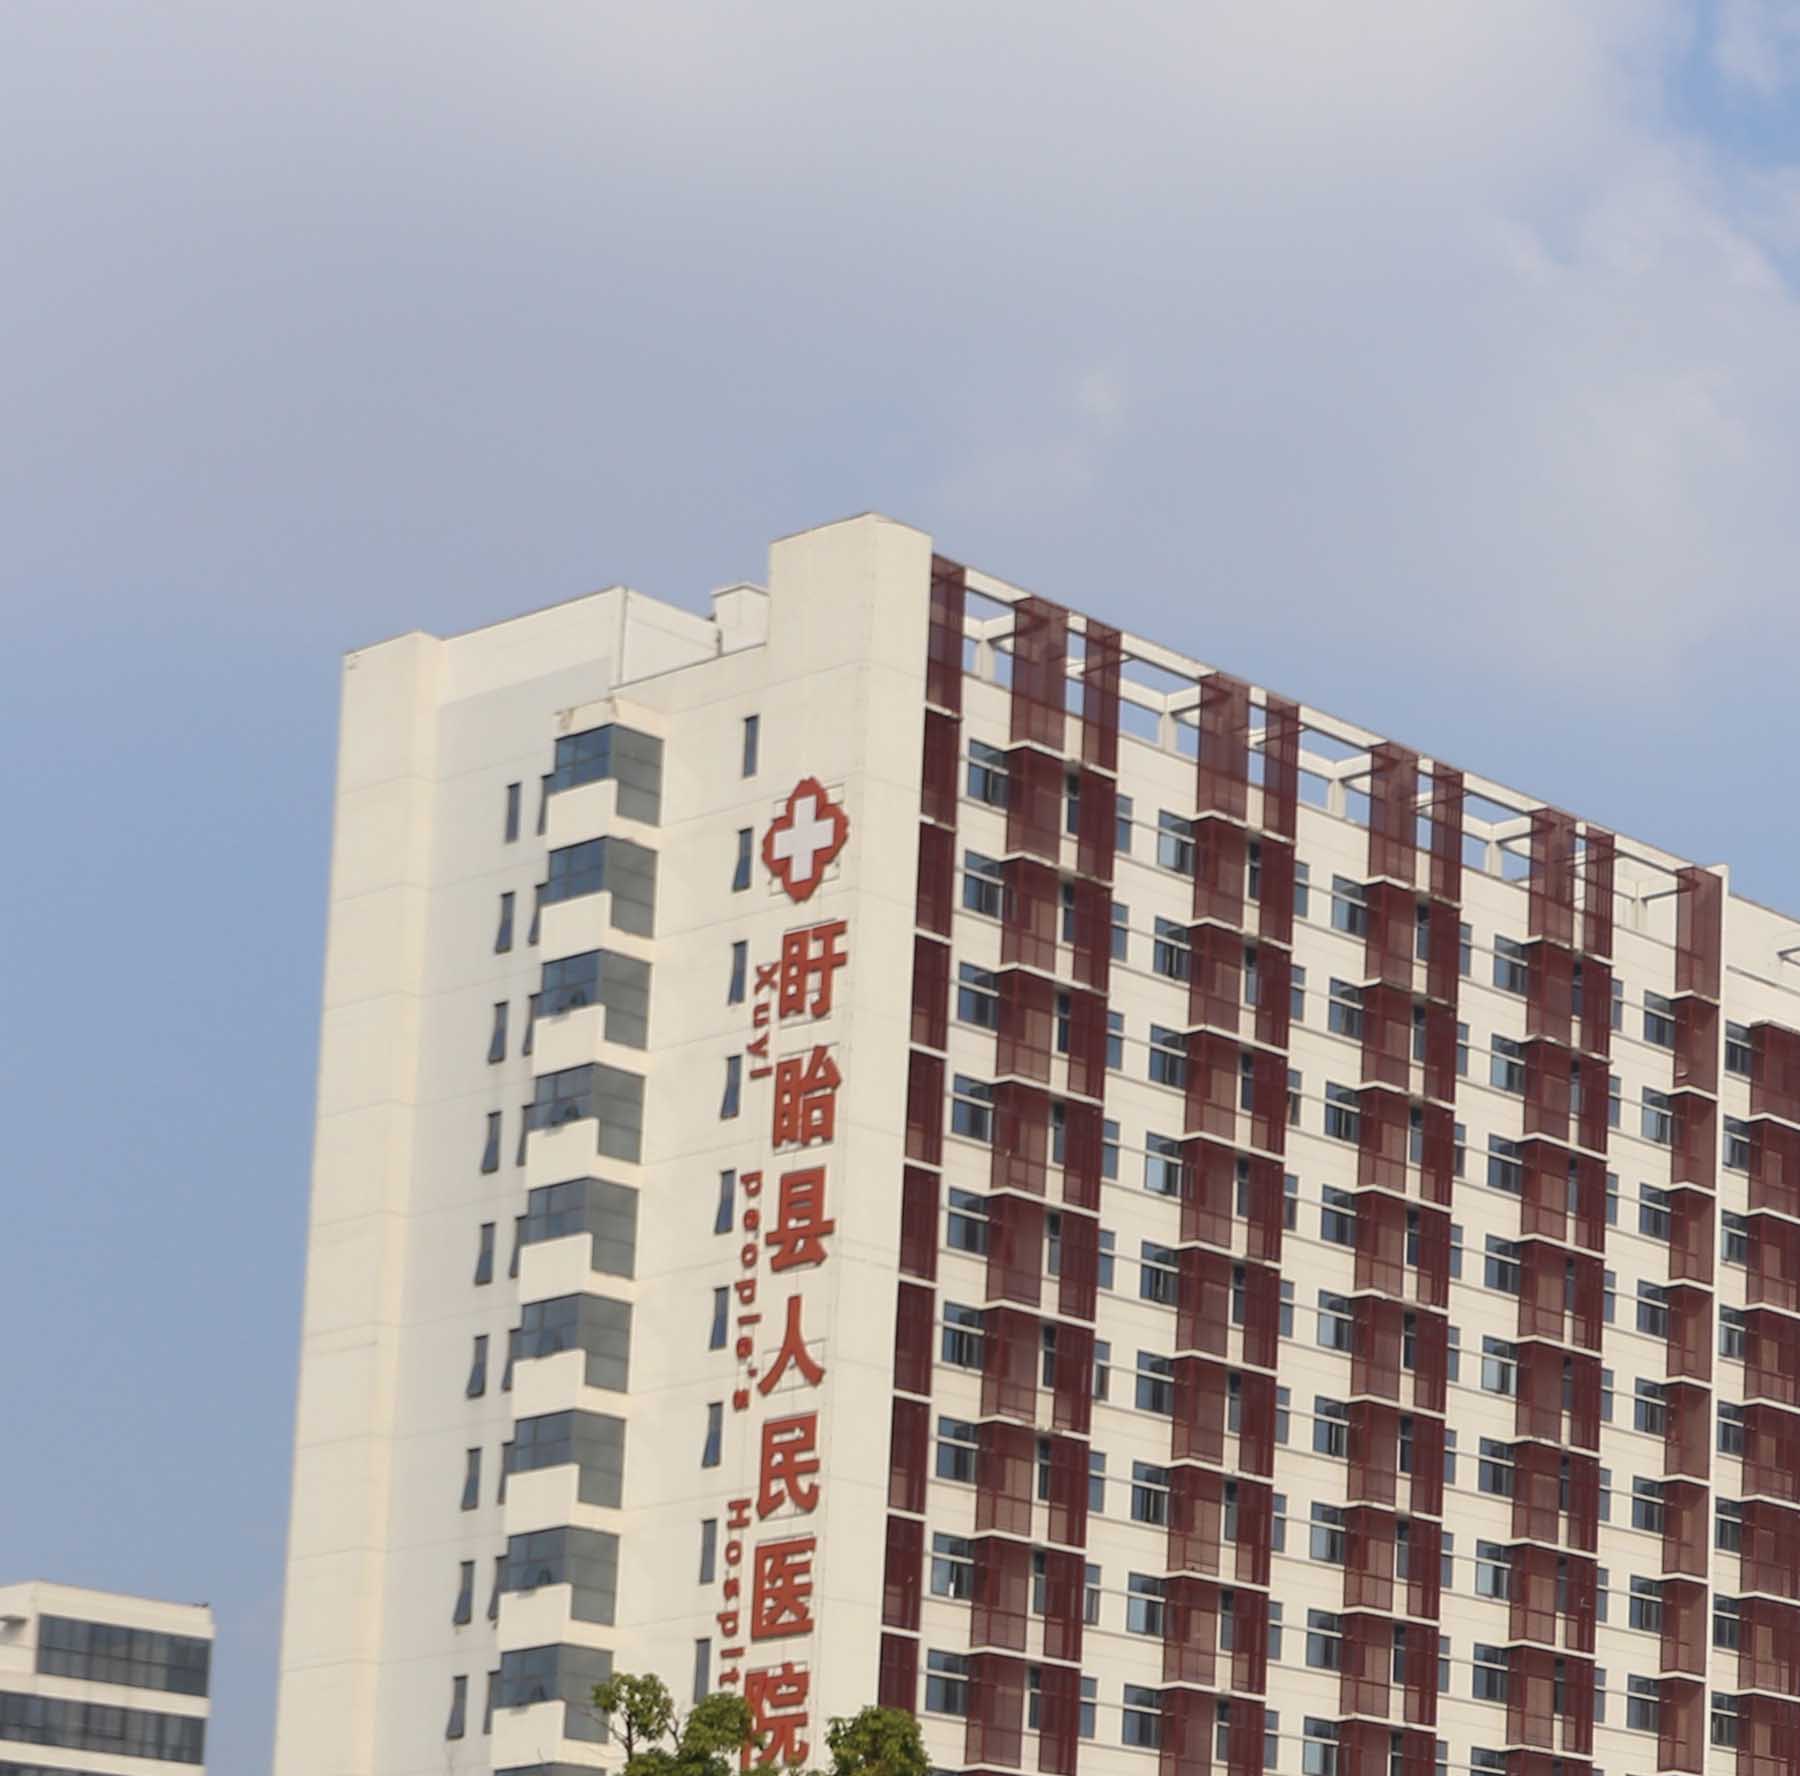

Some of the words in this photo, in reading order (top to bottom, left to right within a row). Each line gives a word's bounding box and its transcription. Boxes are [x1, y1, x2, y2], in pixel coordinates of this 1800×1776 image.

[718, 1498, 752, 1690] Hospit
[739, 920, 848, 1768] 盱眙县人民医院
